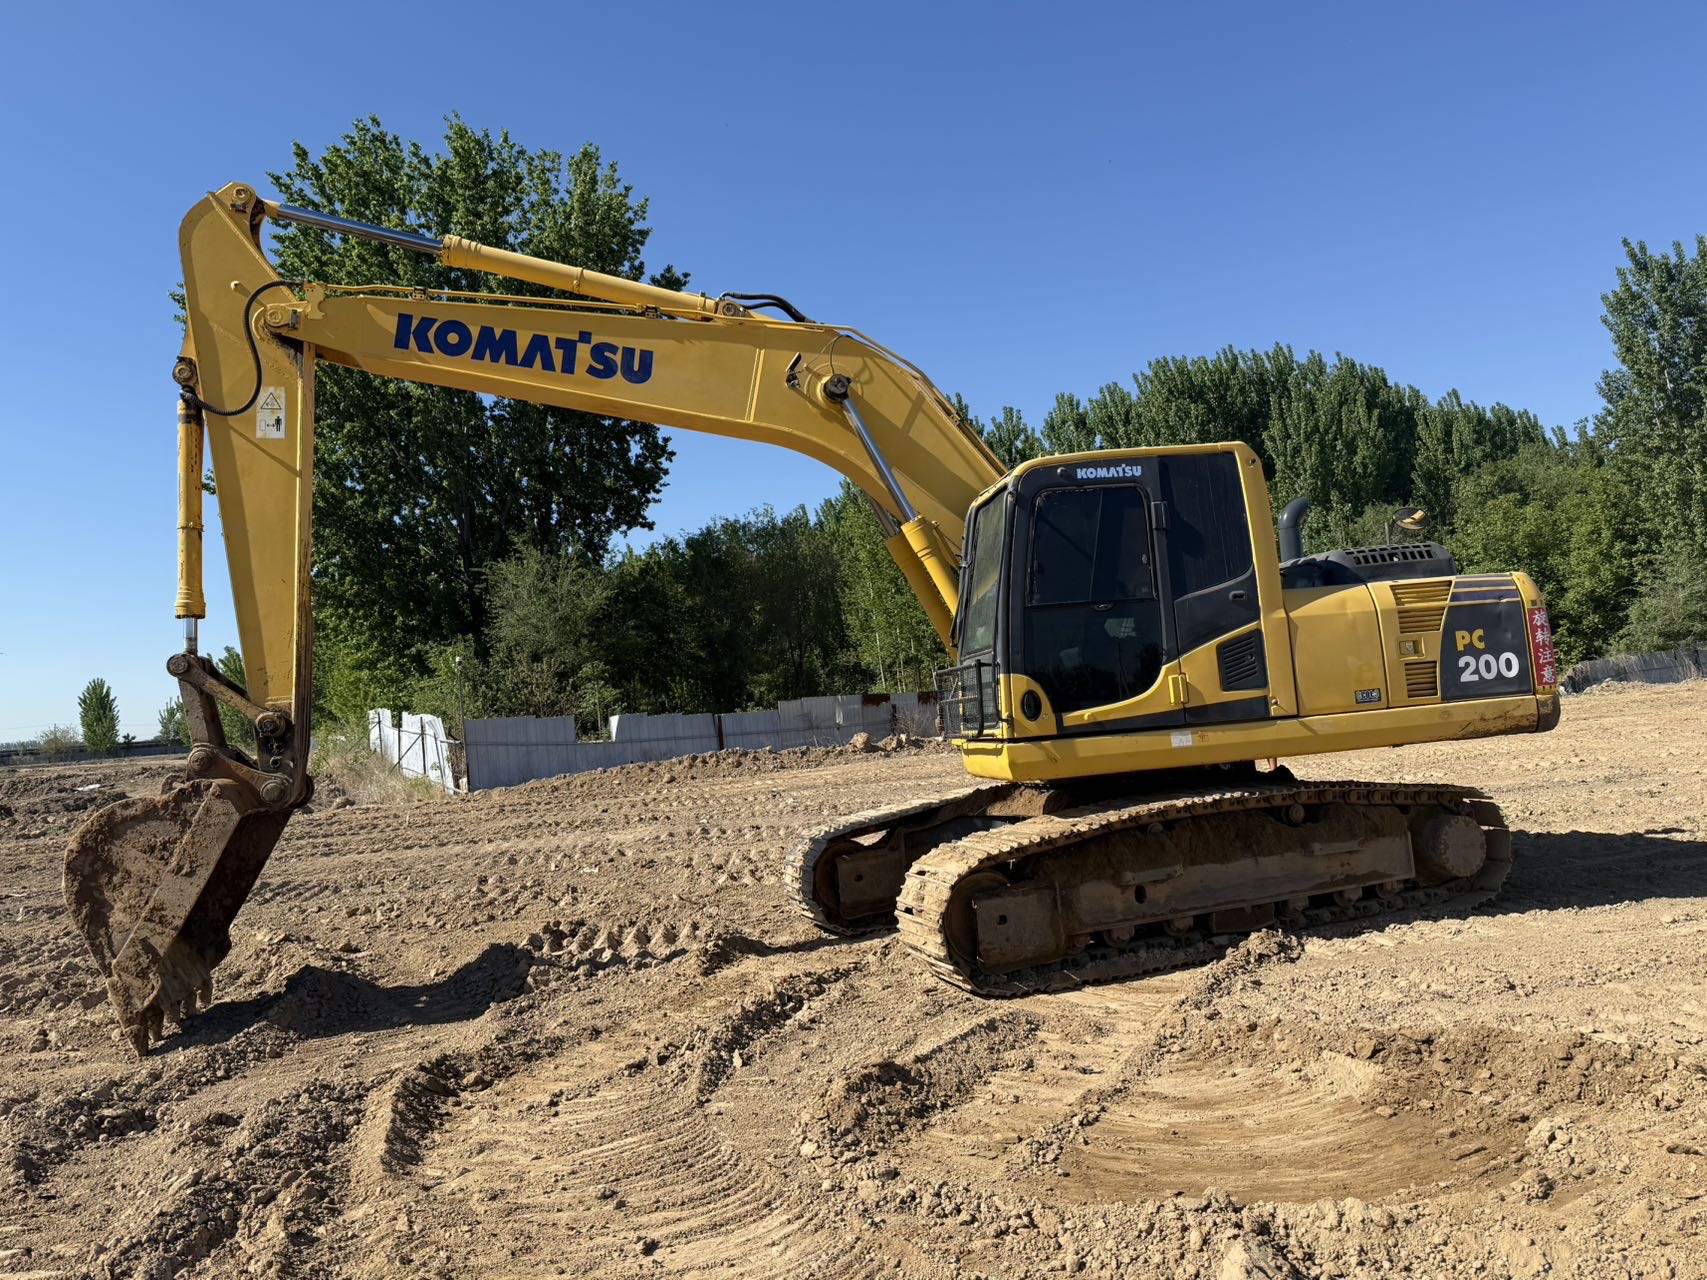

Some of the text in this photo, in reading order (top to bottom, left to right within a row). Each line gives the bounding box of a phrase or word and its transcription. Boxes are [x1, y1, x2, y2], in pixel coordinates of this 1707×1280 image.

[394, 313, 654, 384] KOMATSU
[1076, 464, 1142, 479] KOMATSU
[1455, 629, 1485, 651] PC
[1532, 610, 1555, 683] 旋转注意
[1458, 652, 1519, 682] 200
